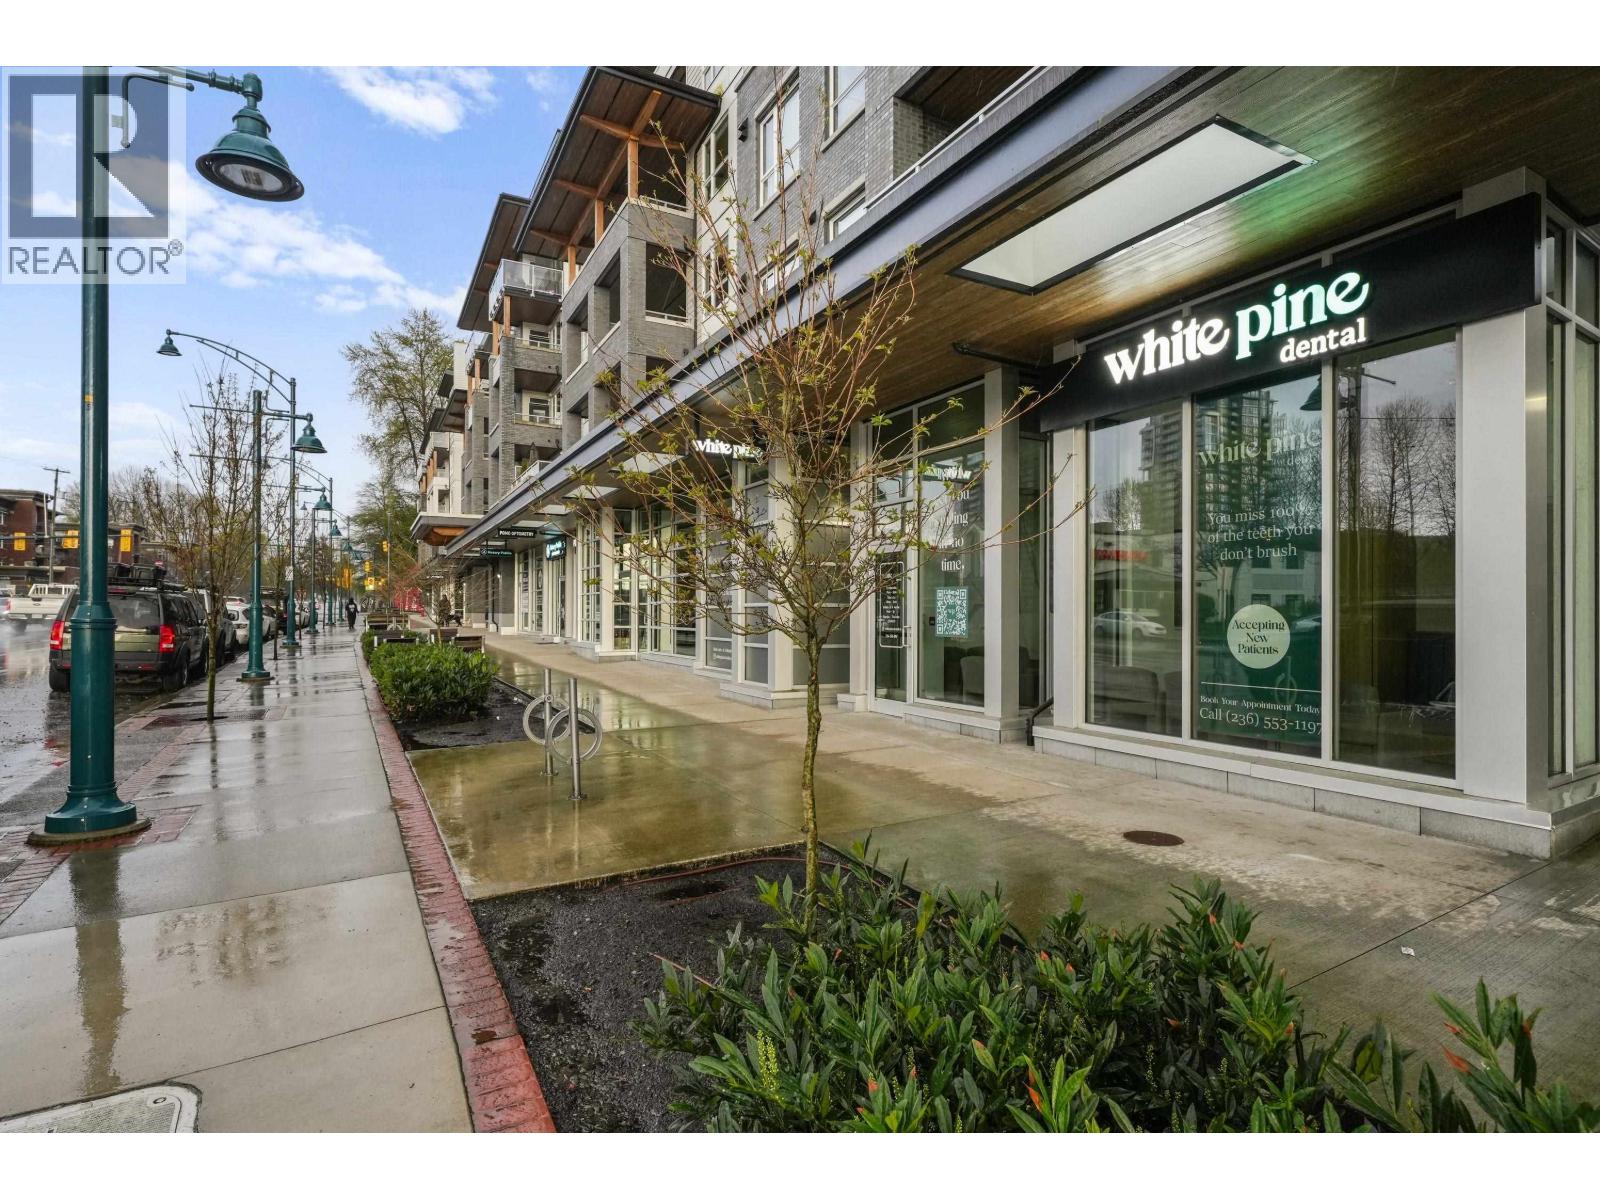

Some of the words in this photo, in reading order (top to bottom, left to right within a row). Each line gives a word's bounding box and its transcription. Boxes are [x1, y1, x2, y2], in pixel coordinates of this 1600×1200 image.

[1104, 318, 1230, 384] white
[1236, 272, 1370, 360] pine
[1279, 317, 1367, 363] dental
[1199, 439, 1261, 466] white
[1266, 429, 1321, 461] pine
[1207, 511, 1231, 526] You
[1235, 510, 1265, 522] miss
[1208, 529, 1221, 543] of
[1223, 528, 1244, 541] the
[1247, 525, 1281, 539] teeth
[1284, 525, 1314, 540] you
[1220, 546, 1254, 561] don't
[1257, 543, 1297, 559] brush
[1232, 620, 1285, 631] Accepting
[1246, 632, 1269, 643] New
[1237, 643, 1279, 655] Patients
[1200, 695, 1219, 704] Book
[1221, 697, 1239, 706] Your
[1241, 699, 1292, 711] Appointment
[1199, 707, 1222, 721] Call
[1226, 710, 1259, 727] (236)
